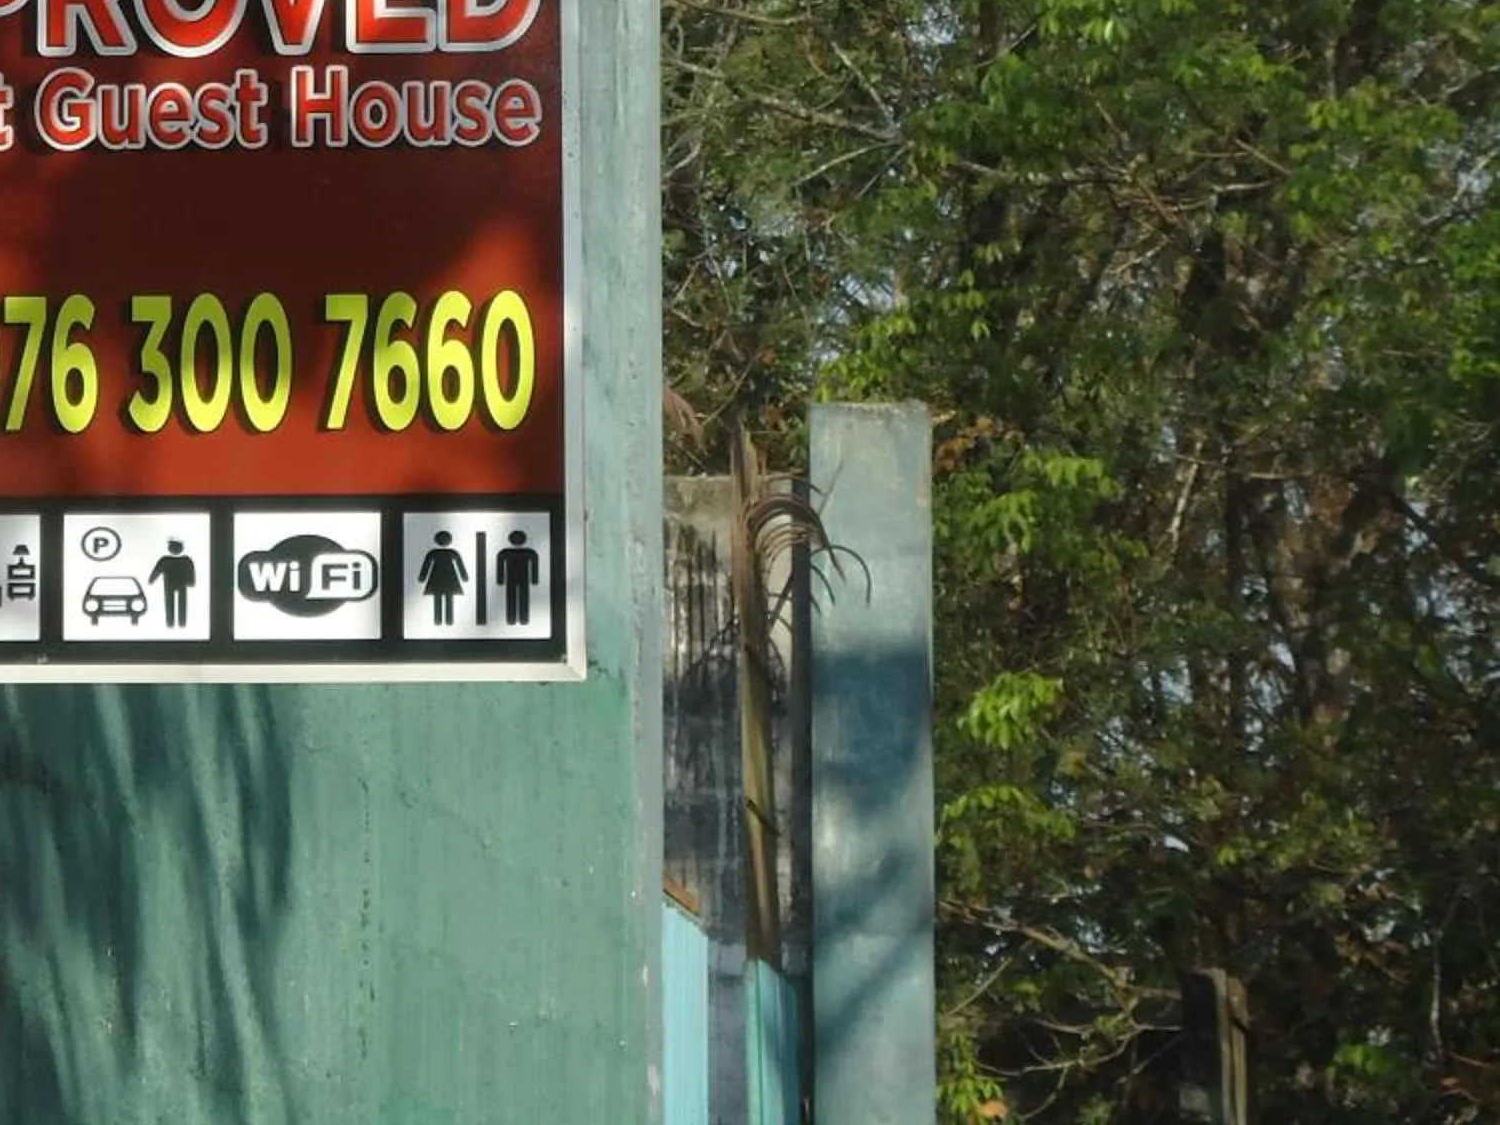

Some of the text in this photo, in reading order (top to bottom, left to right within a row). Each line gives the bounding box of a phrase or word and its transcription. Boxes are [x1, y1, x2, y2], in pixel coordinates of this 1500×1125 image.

[34, 67, 268, 152] Guest
[289, 63, 542, 151] House
[127, 292, 292, 433] 300
[323, 289, 536, 432] 7660
